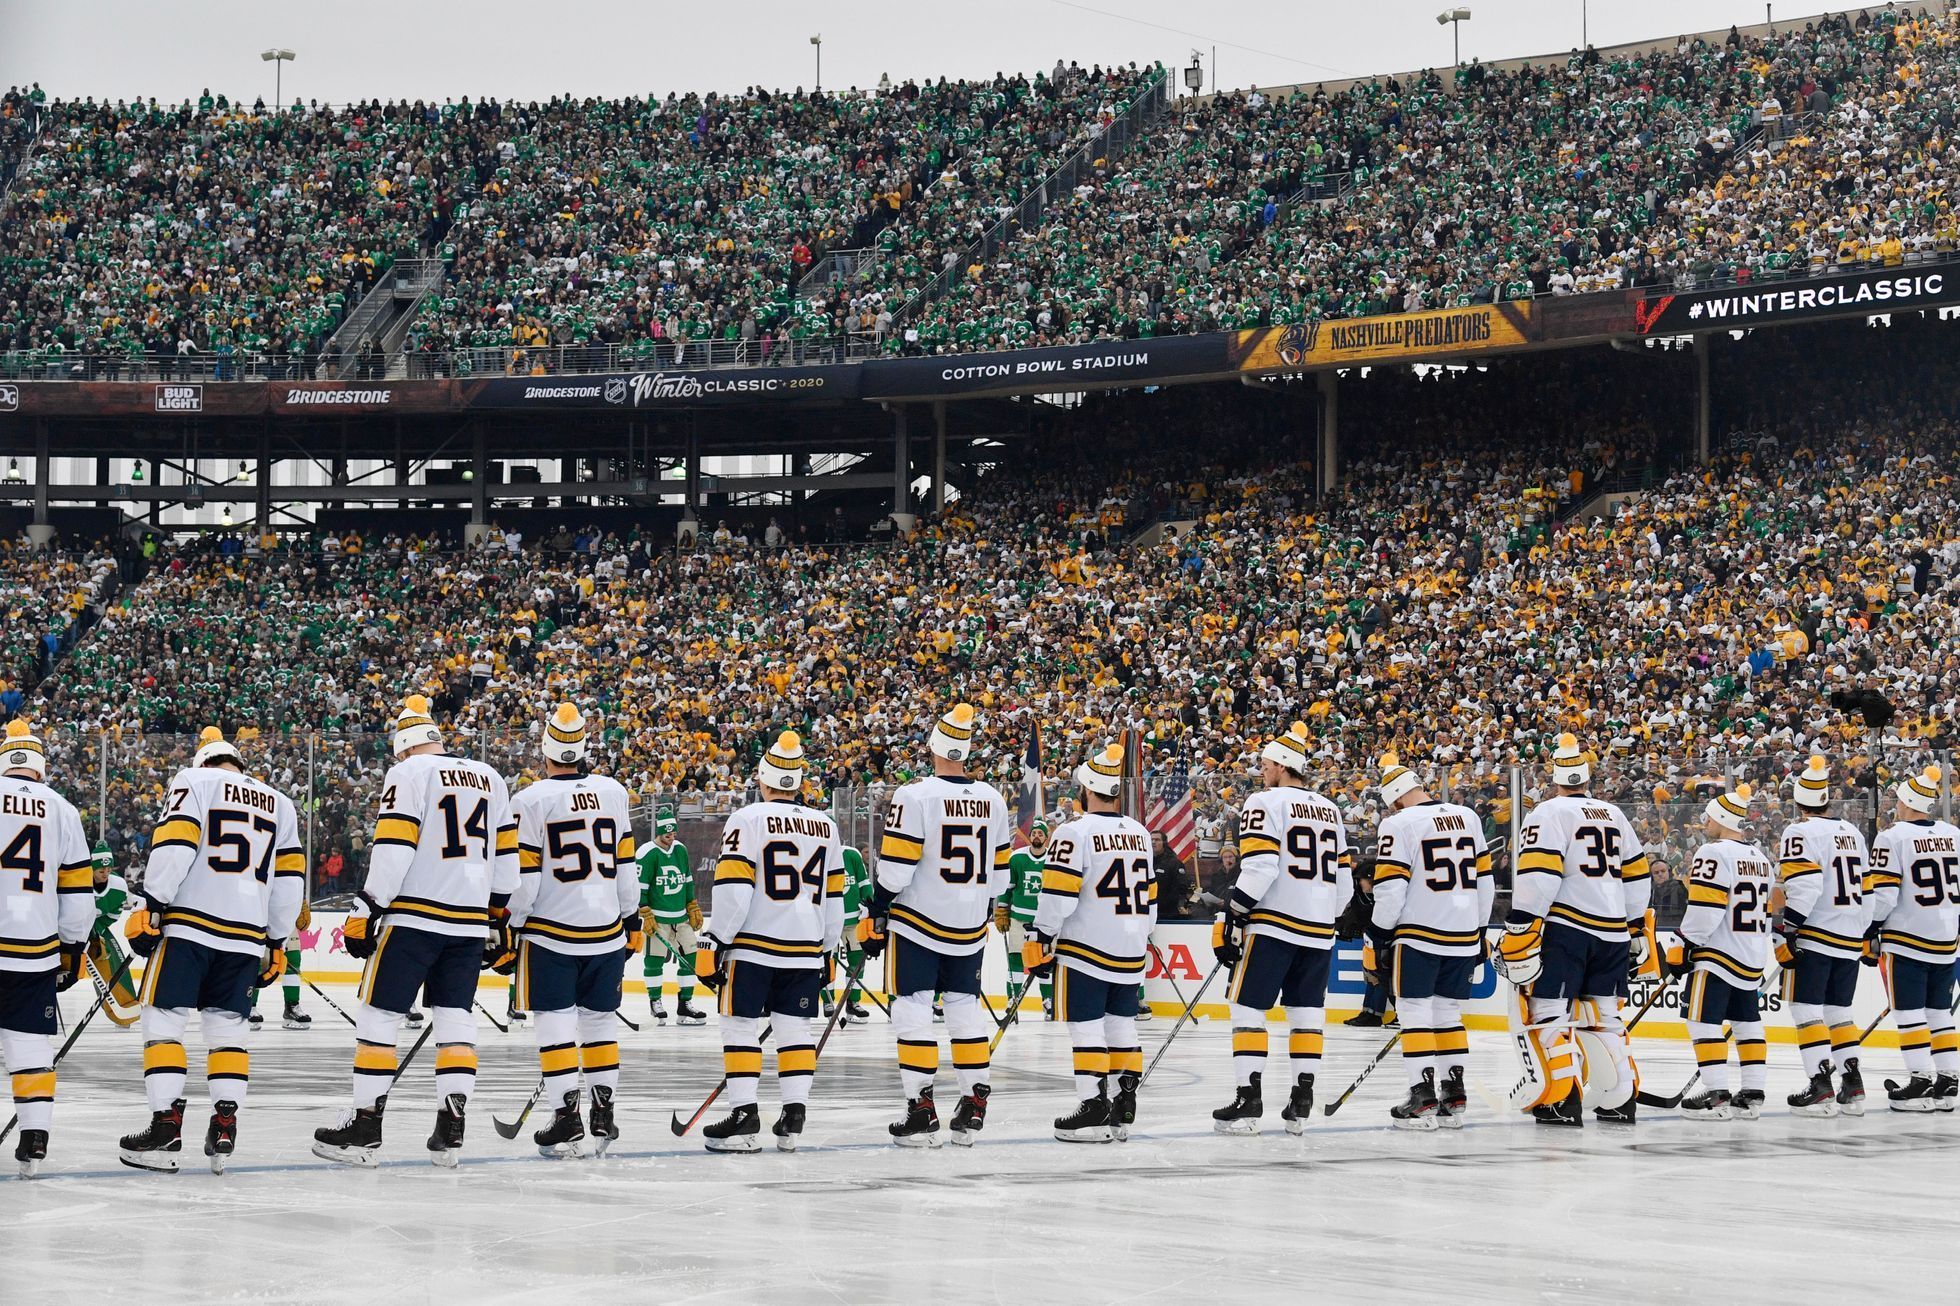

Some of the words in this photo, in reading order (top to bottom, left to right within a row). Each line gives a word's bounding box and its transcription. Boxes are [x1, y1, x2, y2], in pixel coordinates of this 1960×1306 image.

[1688, 274, 1944, 320] #WINTERCLASSIC
[1331, 319, 1403, 350] NASHVILLE
[1404, 311, 1491, 348] PREDATORS
[942, 363, 1010, 381] COTTON
[1015, 359, 1066, 374] BOWL
[1072, 352, 1149, 370] STADIUM
[164, 387, 194, 399] BUD
[286, 389, 391, 404] BRIDGESTONE
[524, 385, 601, 399] BRIDGESTONE
[629, 372, 703, 407] Winter
[704, 378, 779, 393] CLASSIC
[790, 377, 824, 389] 2020
[158, 398, 199, 409] LIGHT
[439, 769, 491, 793] EKHOLM
[3, 794, 46, 818] ELLIS
[224, 783, 276, 814] FABBRO
[570, 793, 601, 812] JOSI
[944, 799, 991, 819] WATSON
[438, 794, 489, 861] 14
[886, 803, 903, 829] 51
[1240, 808, 1265, 833] 92
[1432, 814, 1466, 832] IRWIN
[1581, 807, 1614, 822] RINNE
[767, 816, 831, 840] GRANLUND
[207, 808, 278, 885] 57
[546, 817, 618, 884] 59
[939, 823, 988, 885] 51
[1047, 838, 1075, 865] 42
[1286, 825, 1338, 885] 92
[1575, 825, 1622, 879] 35
[1783, 836, 1804, 858] 15
[1834, 835, 1857, 851] SMITH
[1914, 837, 1955, 854] DUCHENE
[0, 824, 45, 894] 4
[1421, 836, 1478, 893] 52
[1691, 858, 1718, 880] 23
[1737, 860, 1770, 879] GRIMALDI
[1868, 848, 1890, 867] 95
[762, 840, 829, 906] 64
[1095, 857, 1150, 915] 42
[1832, 856, 1862, 906] 15
[1911, 857, 1960, 906] 95
[1517, 1033, 1538, 1083] CCM
